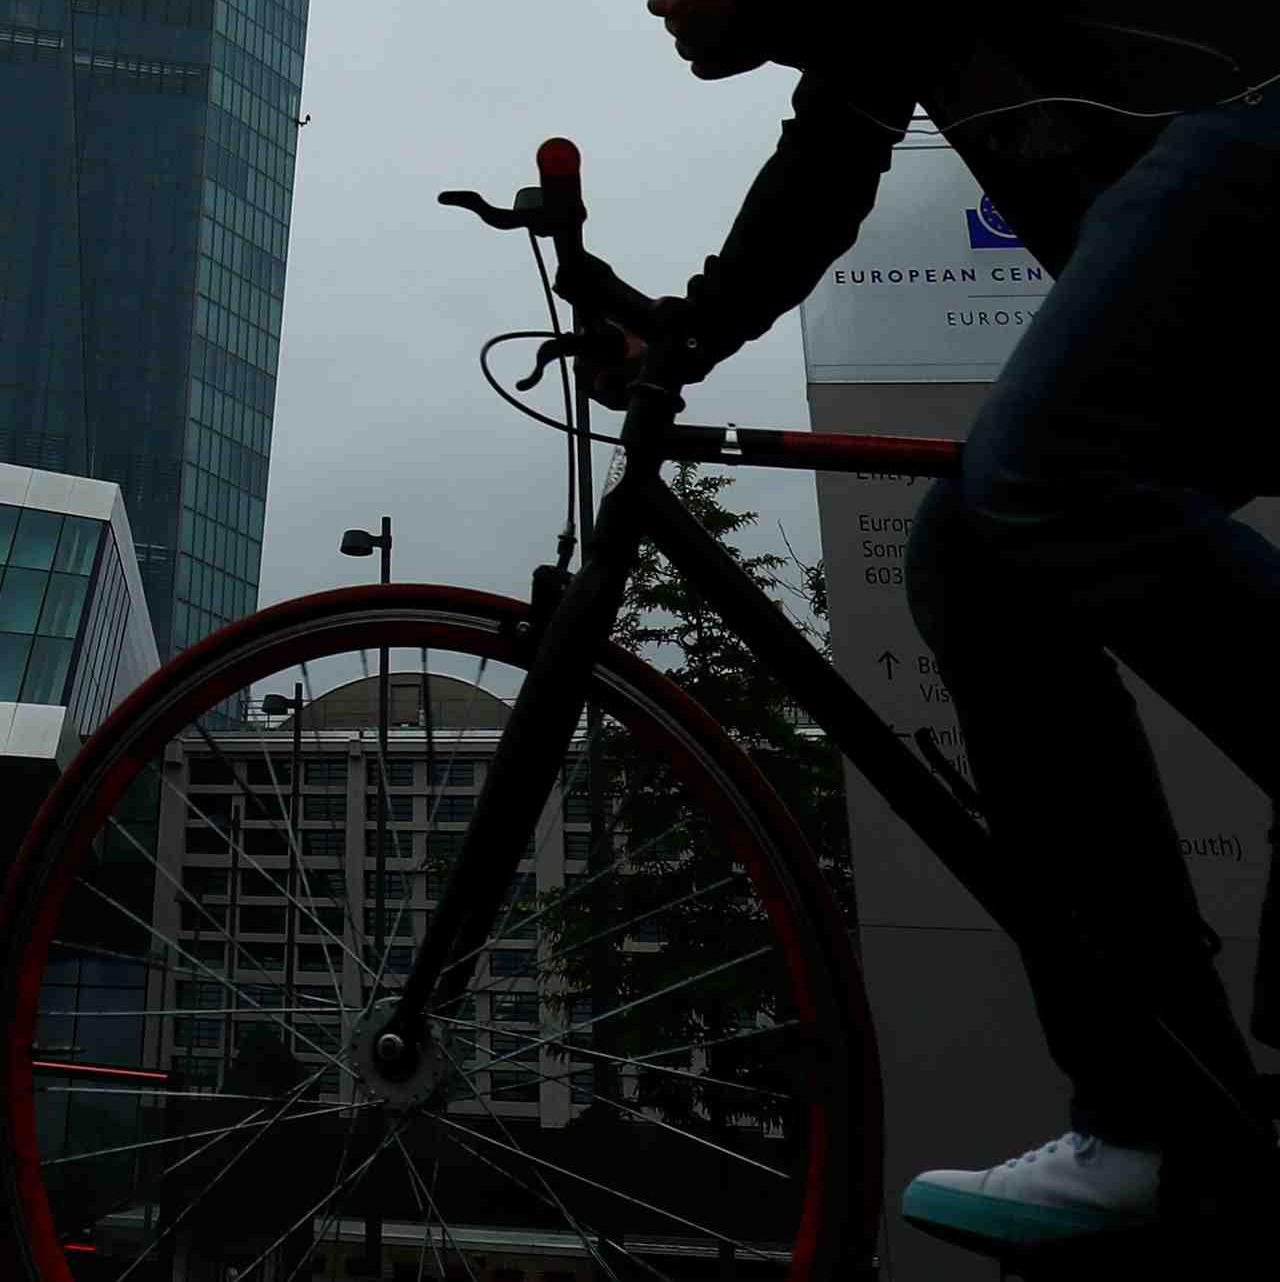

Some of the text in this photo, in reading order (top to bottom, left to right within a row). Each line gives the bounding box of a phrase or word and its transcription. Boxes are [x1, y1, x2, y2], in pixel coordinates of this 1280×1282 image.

[835, 267, 1042, 284] EUROPEAN CEN
[864, 566, 904, 584] 603
[919, 683, 952, 703] Vis
